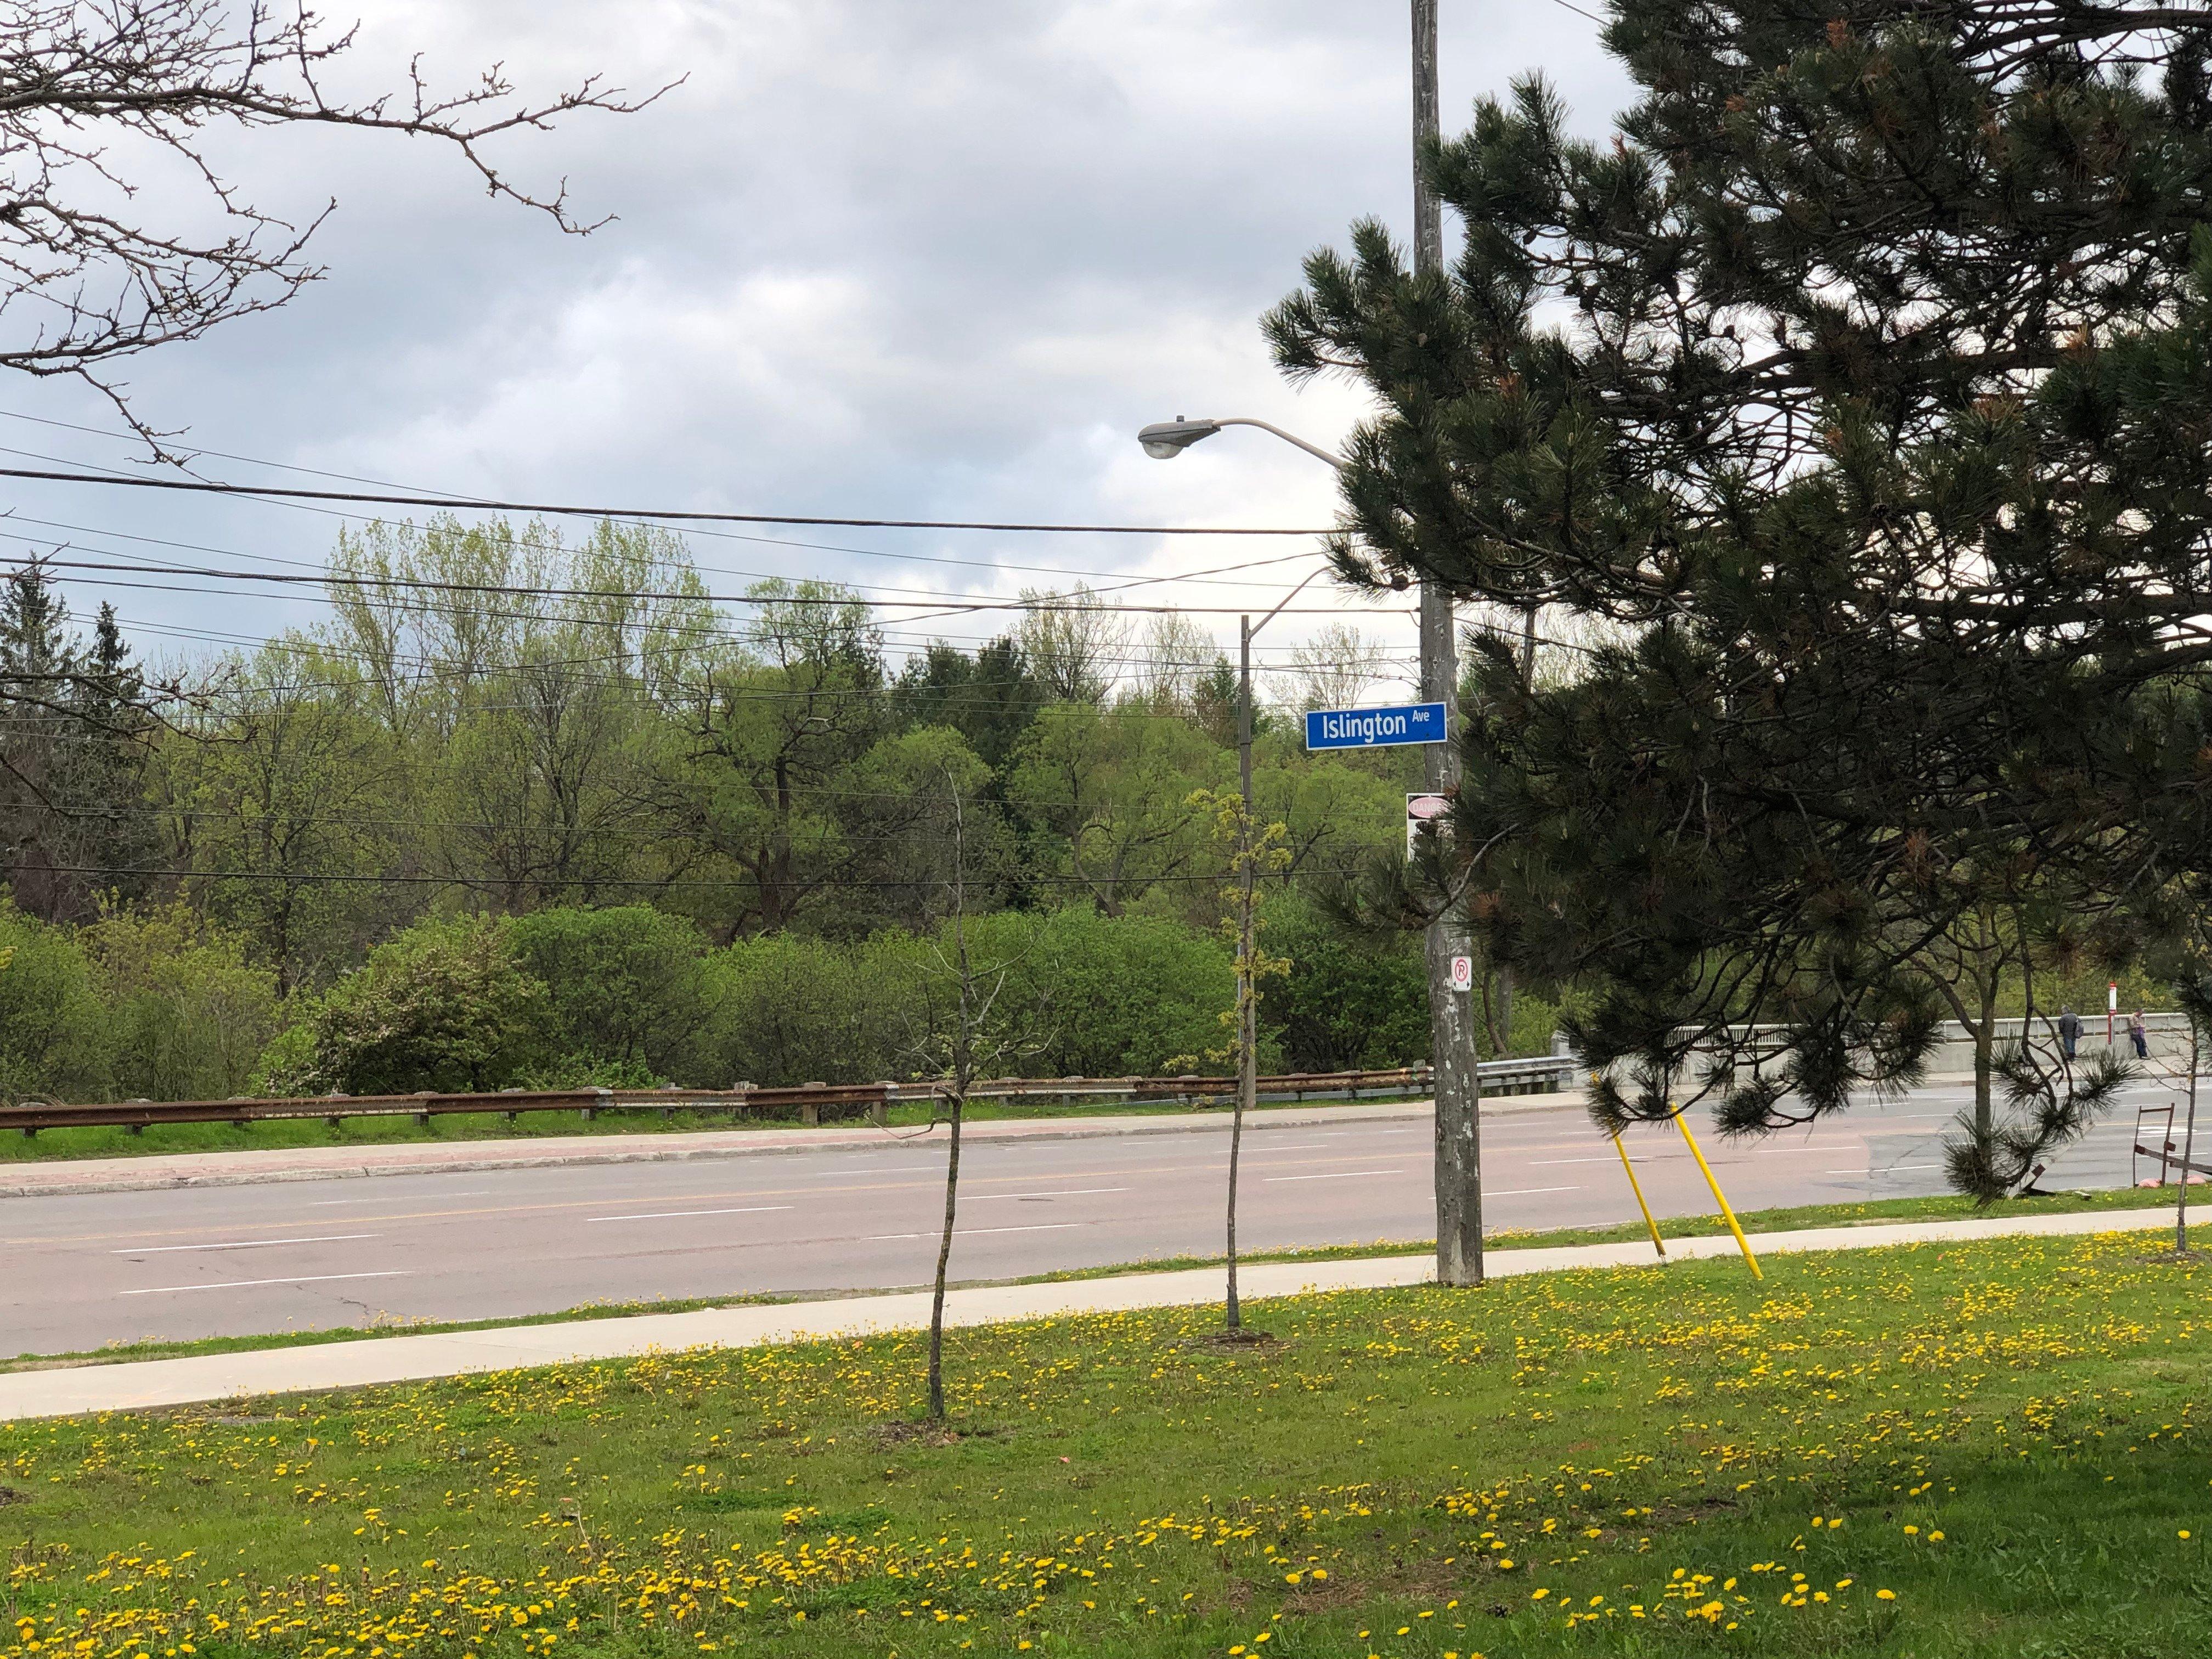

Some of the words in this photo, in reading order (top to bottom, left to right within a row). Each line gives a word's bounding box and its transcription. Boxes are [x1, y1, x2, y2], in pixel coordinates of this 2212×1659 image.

[1323, 713, 1406, 743] Islington
[1412, 709, 1430, 723] Ave
[1413, 803, 1442, 812] DANG
